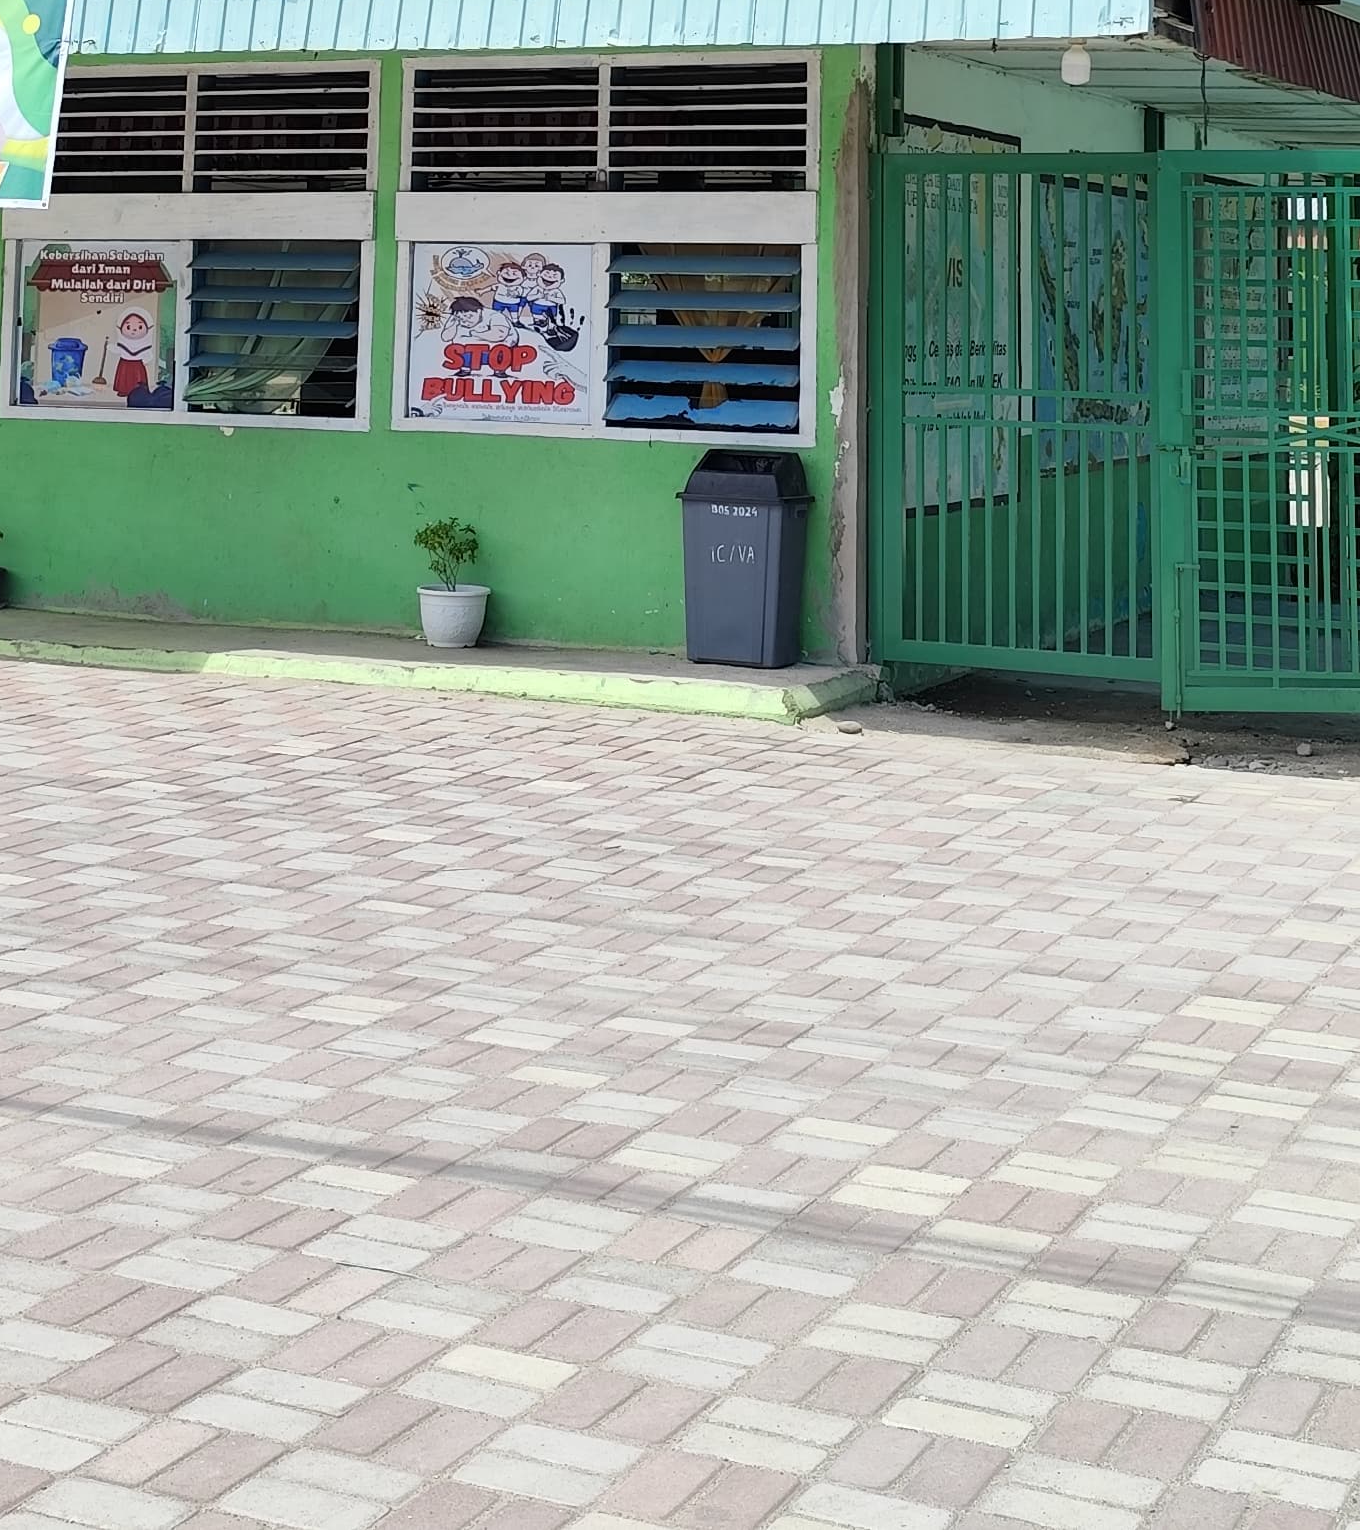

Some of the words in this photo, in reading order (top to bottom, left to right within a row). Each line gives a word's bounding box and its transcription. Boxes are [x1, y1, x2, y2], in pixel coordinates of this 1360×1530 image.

[39, 249, 108, 261] Kebersihan
[109, 249, 165, 263] Sebagian
[71, 263, 97, 274] dari
[98, 263, 131, 275] Iman
[50, 278, 105, 290] Mulailah
[105, 278, 131, 290] dari
[133, 279, 156, 291] Diri
[80, 292, 125, 303] Sendiri
[442, 342, 538, 373] STOP
[421, 377, 576, 406] BULLYING
[732, 506, 758, 518] 2024
